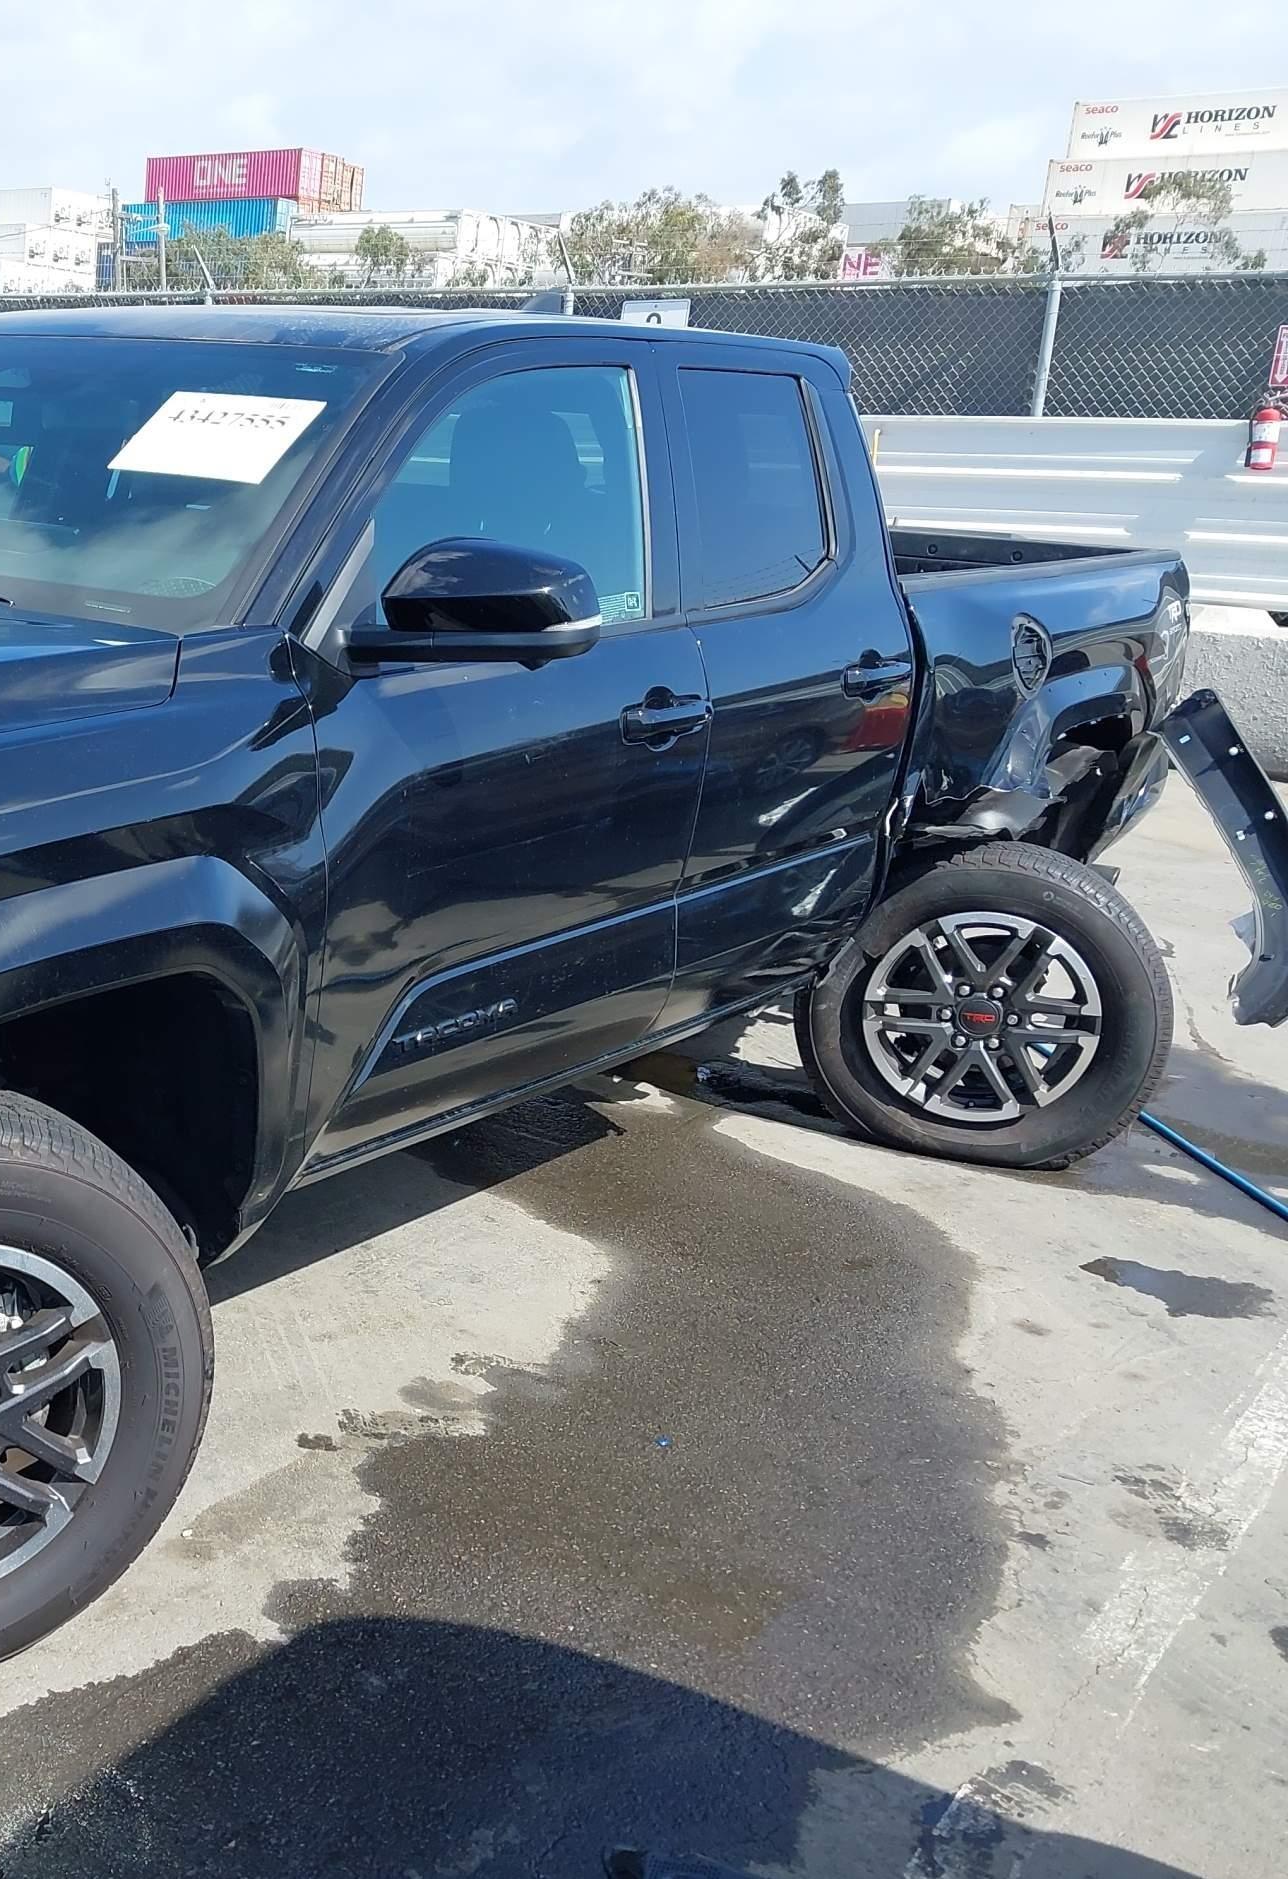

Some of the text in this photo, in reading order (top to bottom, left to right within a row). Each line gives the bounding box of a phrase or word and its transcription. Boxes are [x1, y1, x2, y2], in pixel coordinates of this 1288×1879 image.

[1085, 105, 1119, 115] seaco
[1185, 104, 1278, 124] HORIZON
[1182, 121, 1261, 135] LINES
[193, 157, 249, 187] ONE
[1059, 163, 1093, 173] seaco
[1035, 222, 1069, 231] seco
[961, 1011, 996, 1024] TRD
[392, 998, 518, 1052] TACOMA
[146, 1346, 180, 1486] MICHELIN
